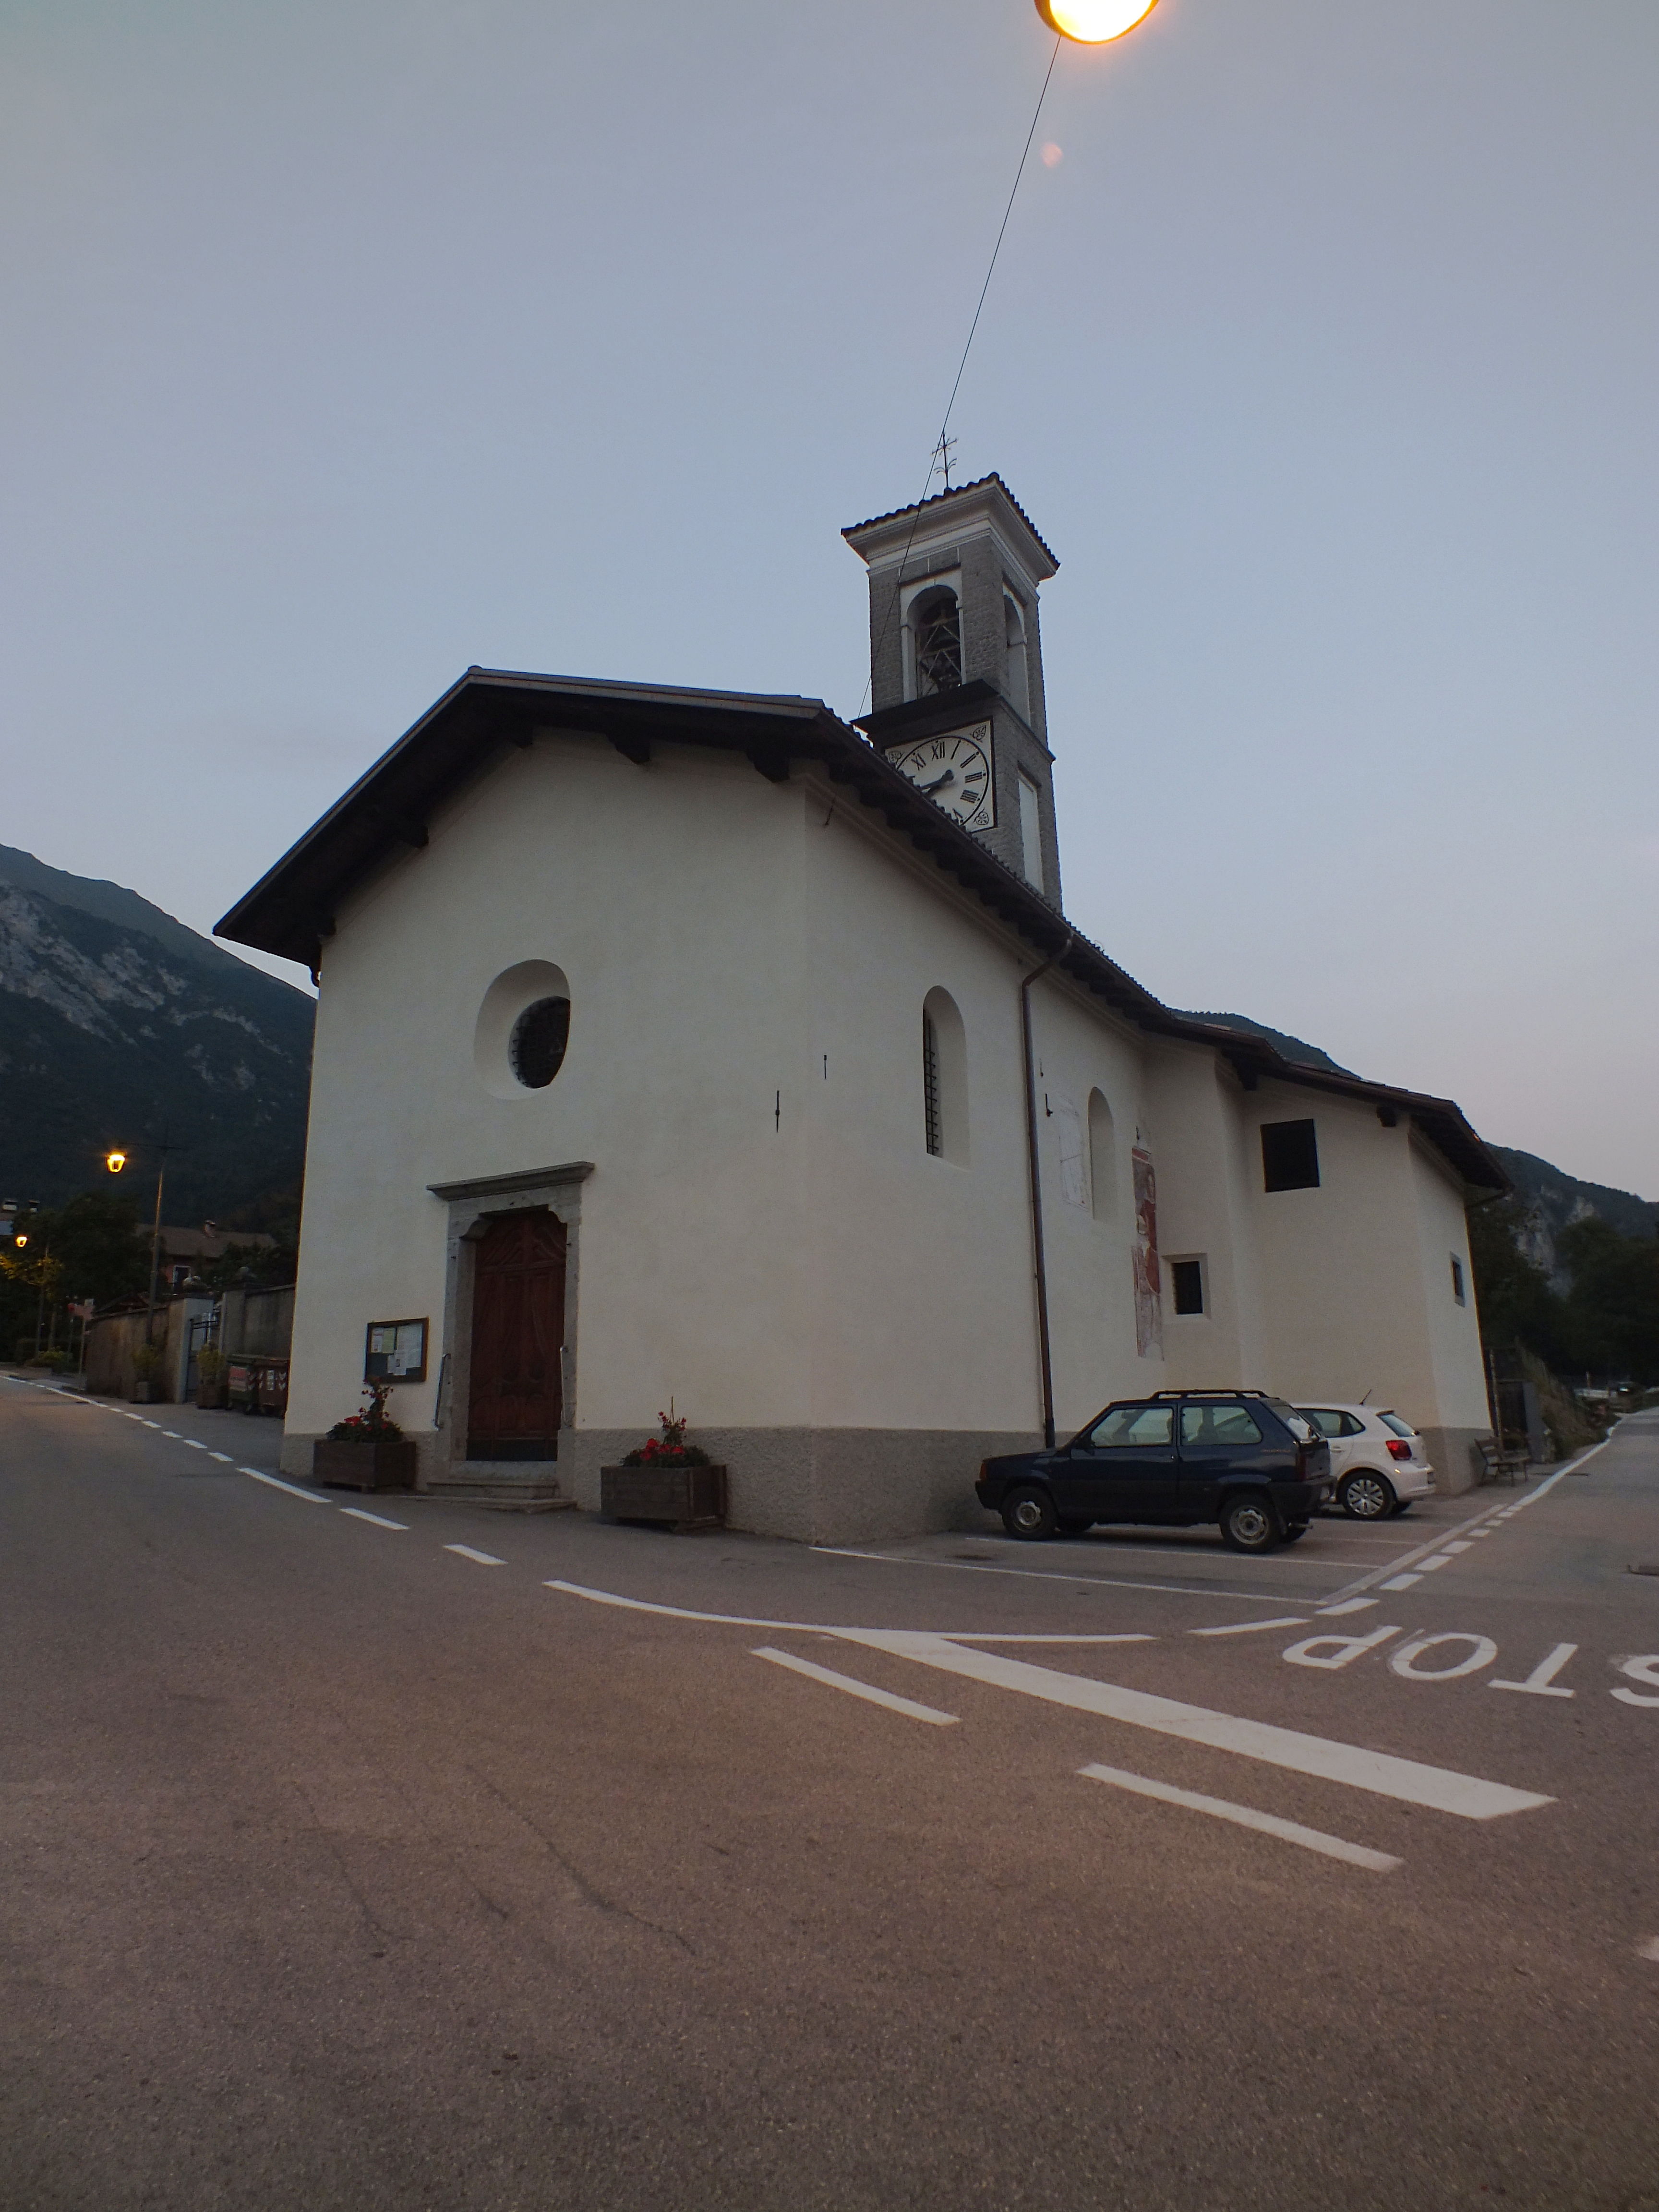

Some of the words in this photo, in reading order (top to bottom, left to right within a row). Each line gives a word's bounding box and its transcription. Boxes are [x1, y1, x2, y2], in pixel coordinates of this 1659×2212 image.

[931, 741, 945, 761] XII
[950, 740, 961, 759] I
[911, 753, 926, 770] XI
[960, 754, 976, 768] II
[965, 772, 982, 783] III
